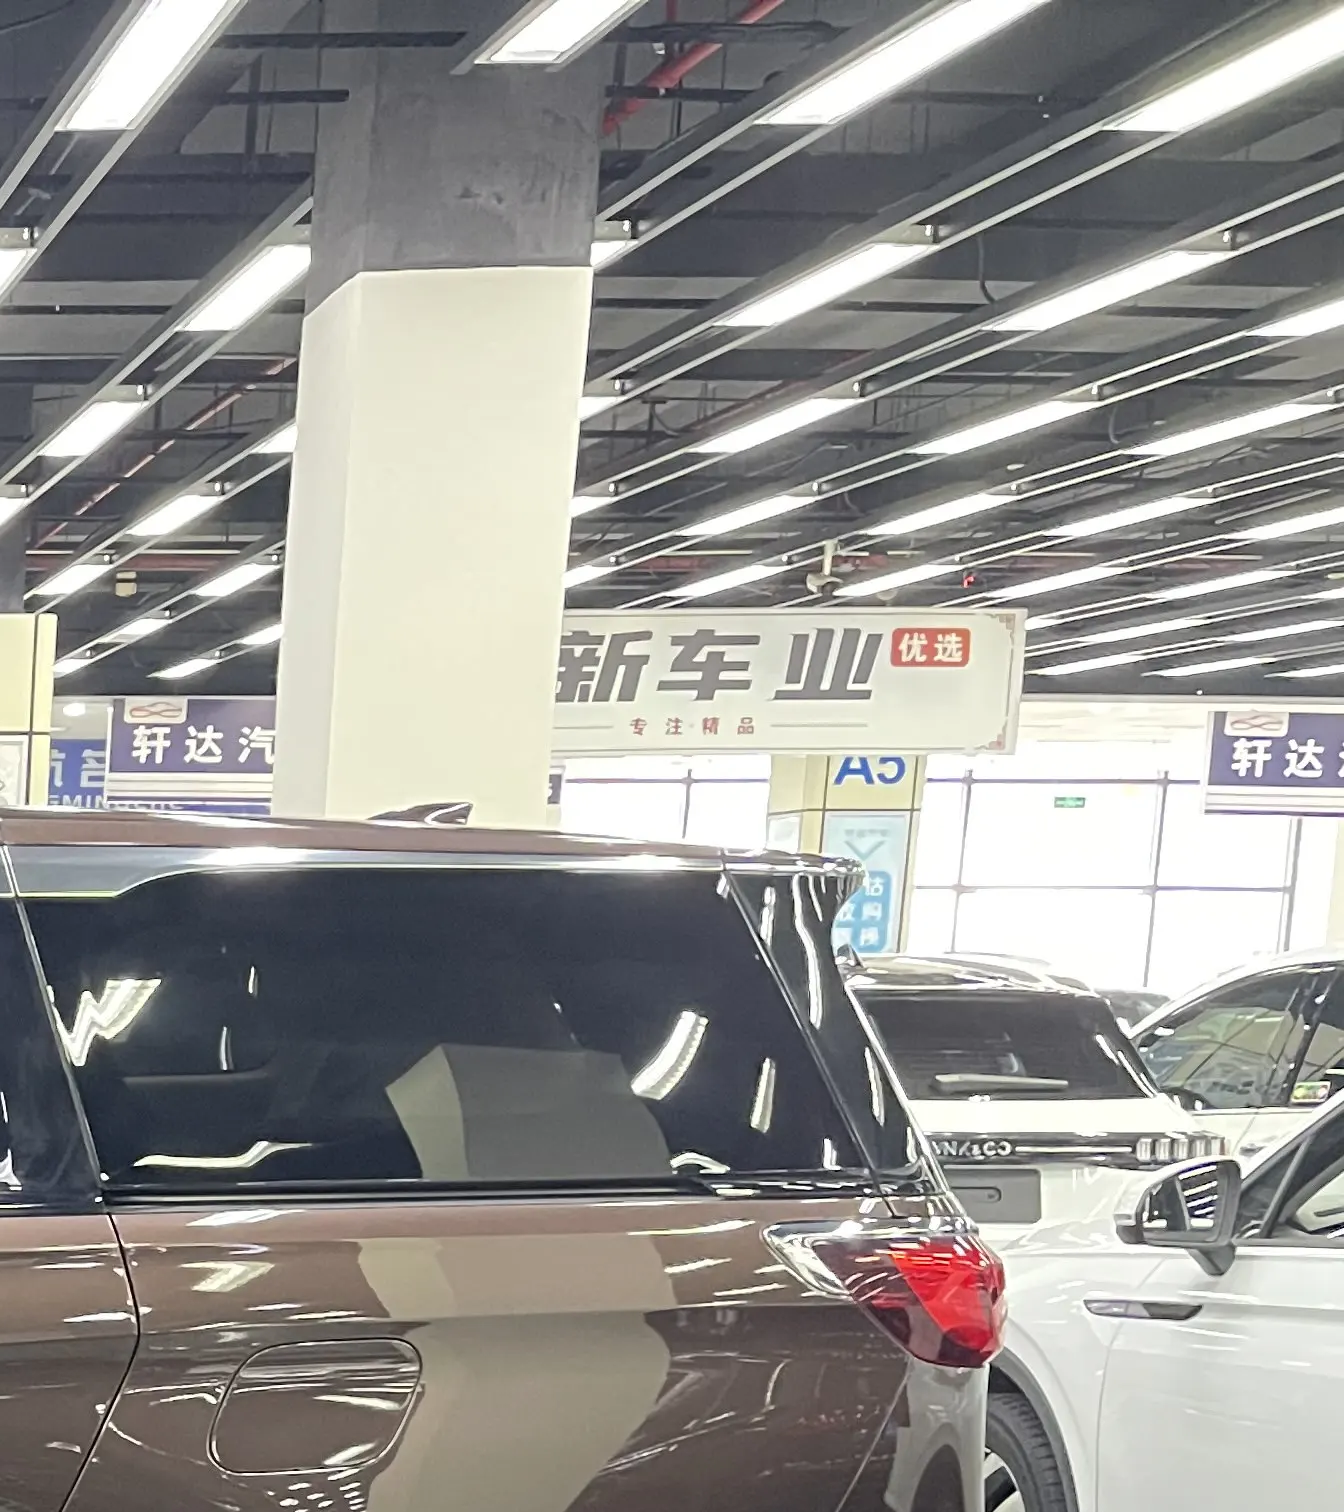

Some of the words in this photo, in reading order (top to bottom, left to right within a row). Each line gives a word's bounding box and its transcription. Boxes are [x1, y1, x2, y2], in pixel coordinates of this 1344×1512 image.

[898, 632, 965, 663] 优选
[131, 724, 276, 765] 轩达汽
[1230, 737, 1344, 779] 轩达
